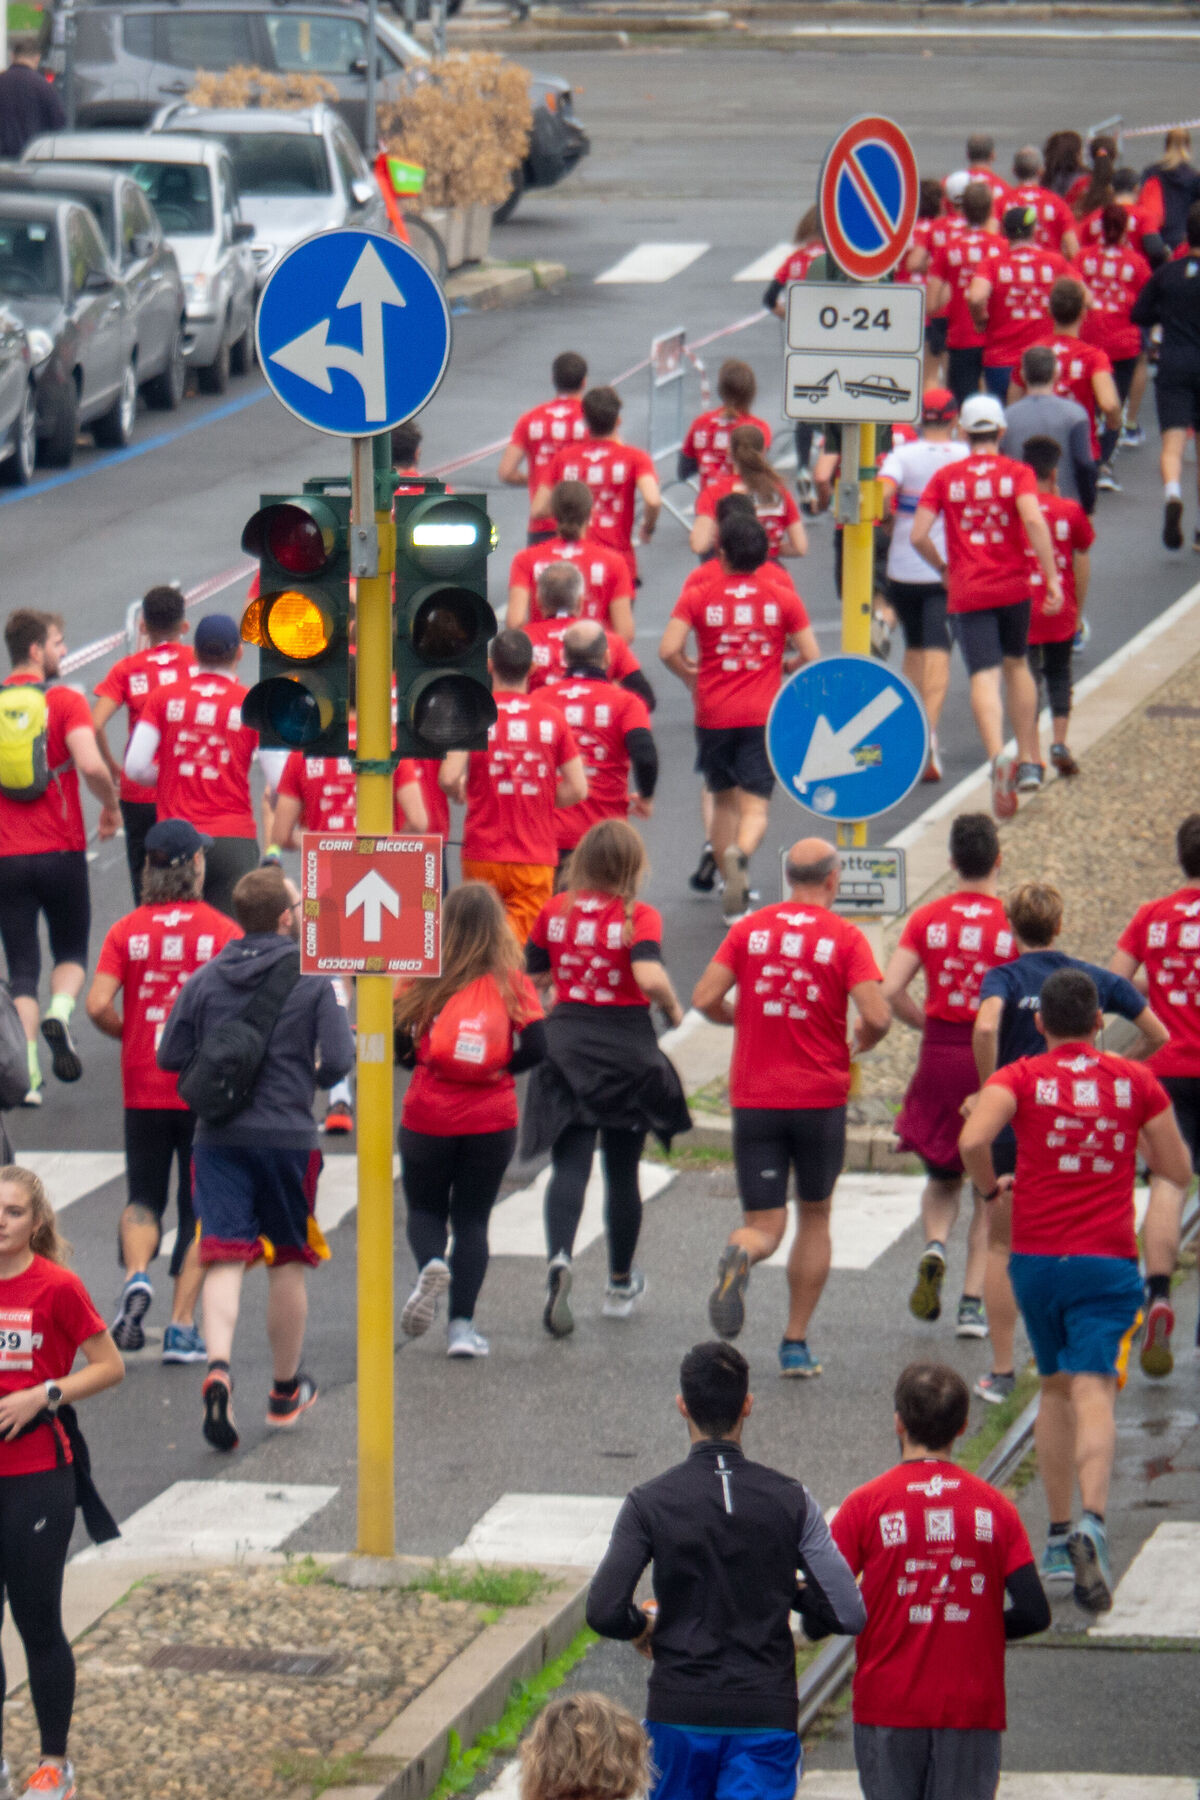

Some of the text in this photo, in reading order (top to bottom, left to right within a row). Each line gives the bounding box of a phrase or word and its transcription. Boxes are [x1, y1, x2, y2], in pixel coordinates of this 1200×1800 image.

[818, 306, 891, 331] 0-24
[318, 840, 424, 852] CORRI BICOCCA
[306, 851, 317, 957] CORRI BICOCCA
[424, 853, 435, 959] CORRI BICOCCA
[317, 958, 423, 970] CORRI BICOCCA
